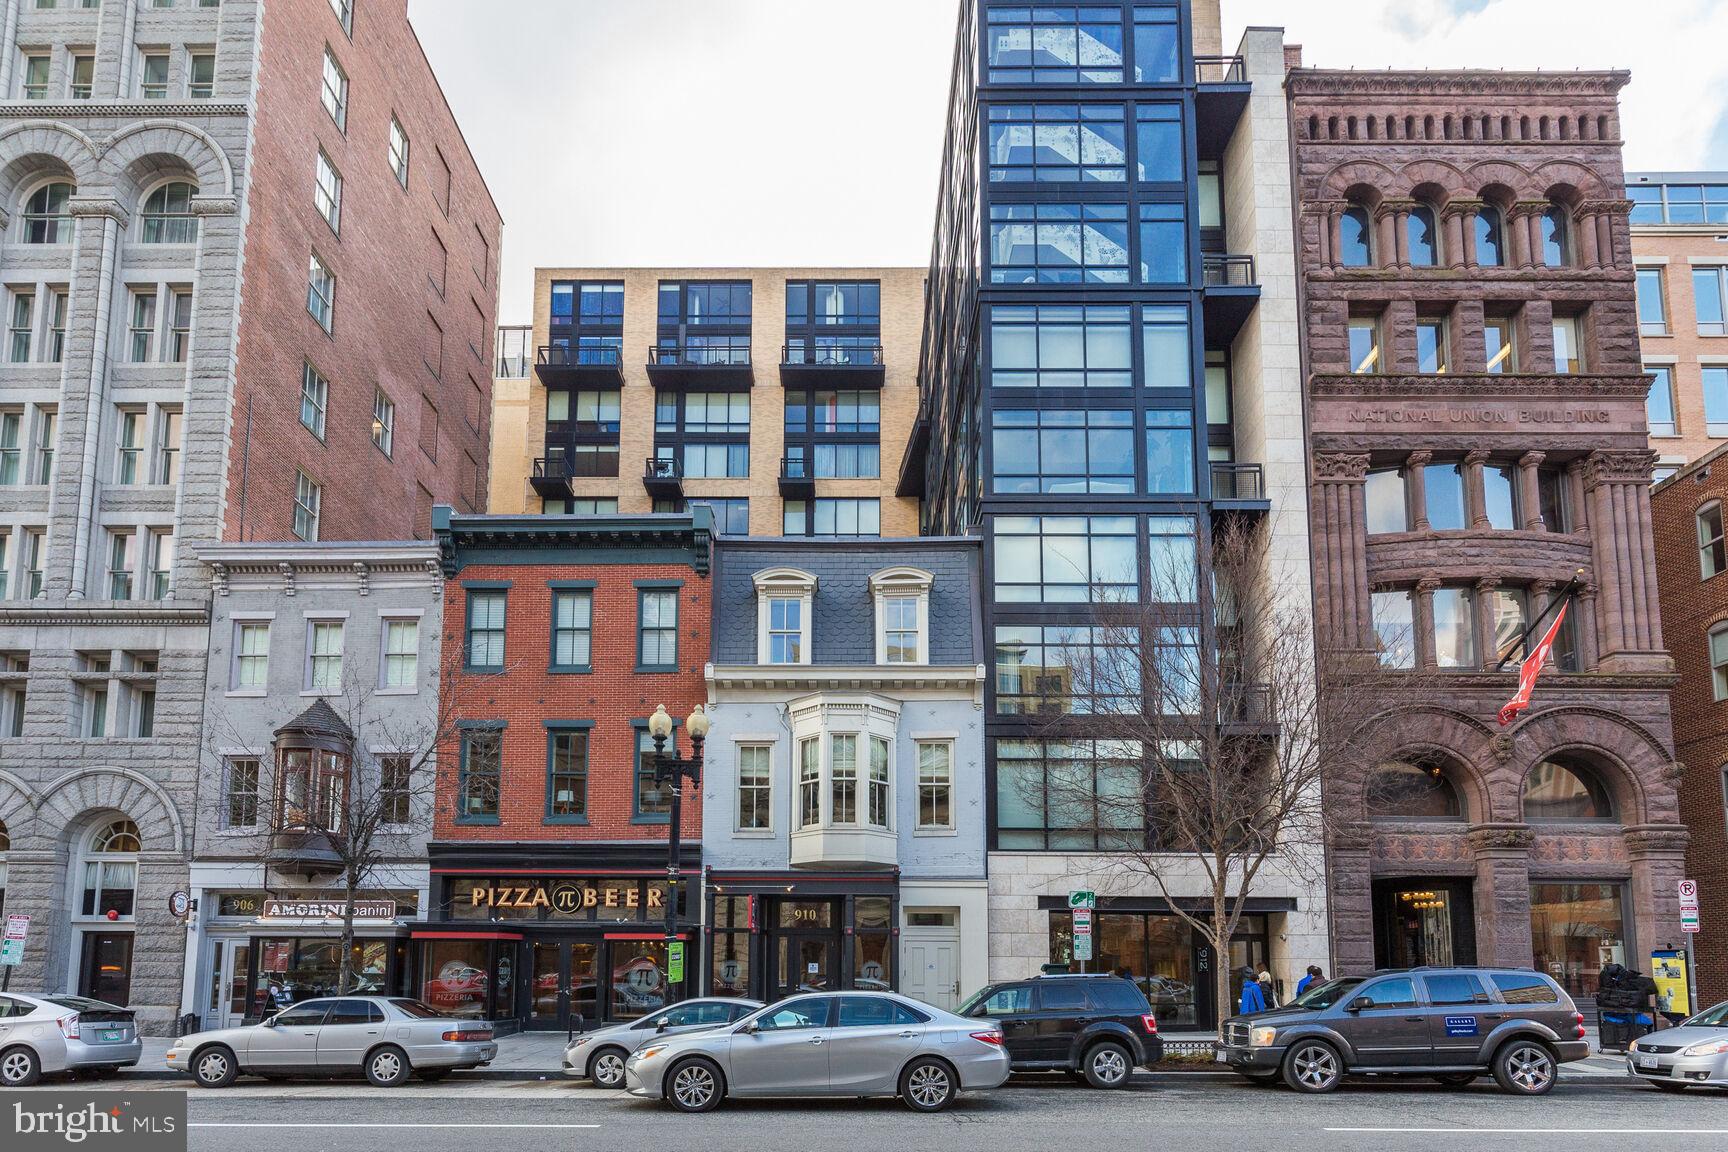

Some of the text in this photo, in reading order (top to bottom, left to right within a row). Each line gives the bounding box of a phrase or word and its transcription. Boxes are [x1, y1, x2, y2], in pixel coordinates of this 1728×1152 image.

[1348, 409, 1610, 424] NATIONAL UNION BUILDING
[472, 887, 550, 907] PIZZA
[583, 888, 663, 907] BEER
[233, 899, 254, 910] 906
[268, 904, 346, 916] AMORINI
[794, 909, 816, 920] 910
[1199, 949, 1208, 970] 912
[435, 993, 473, 1001] PIZZERIA
